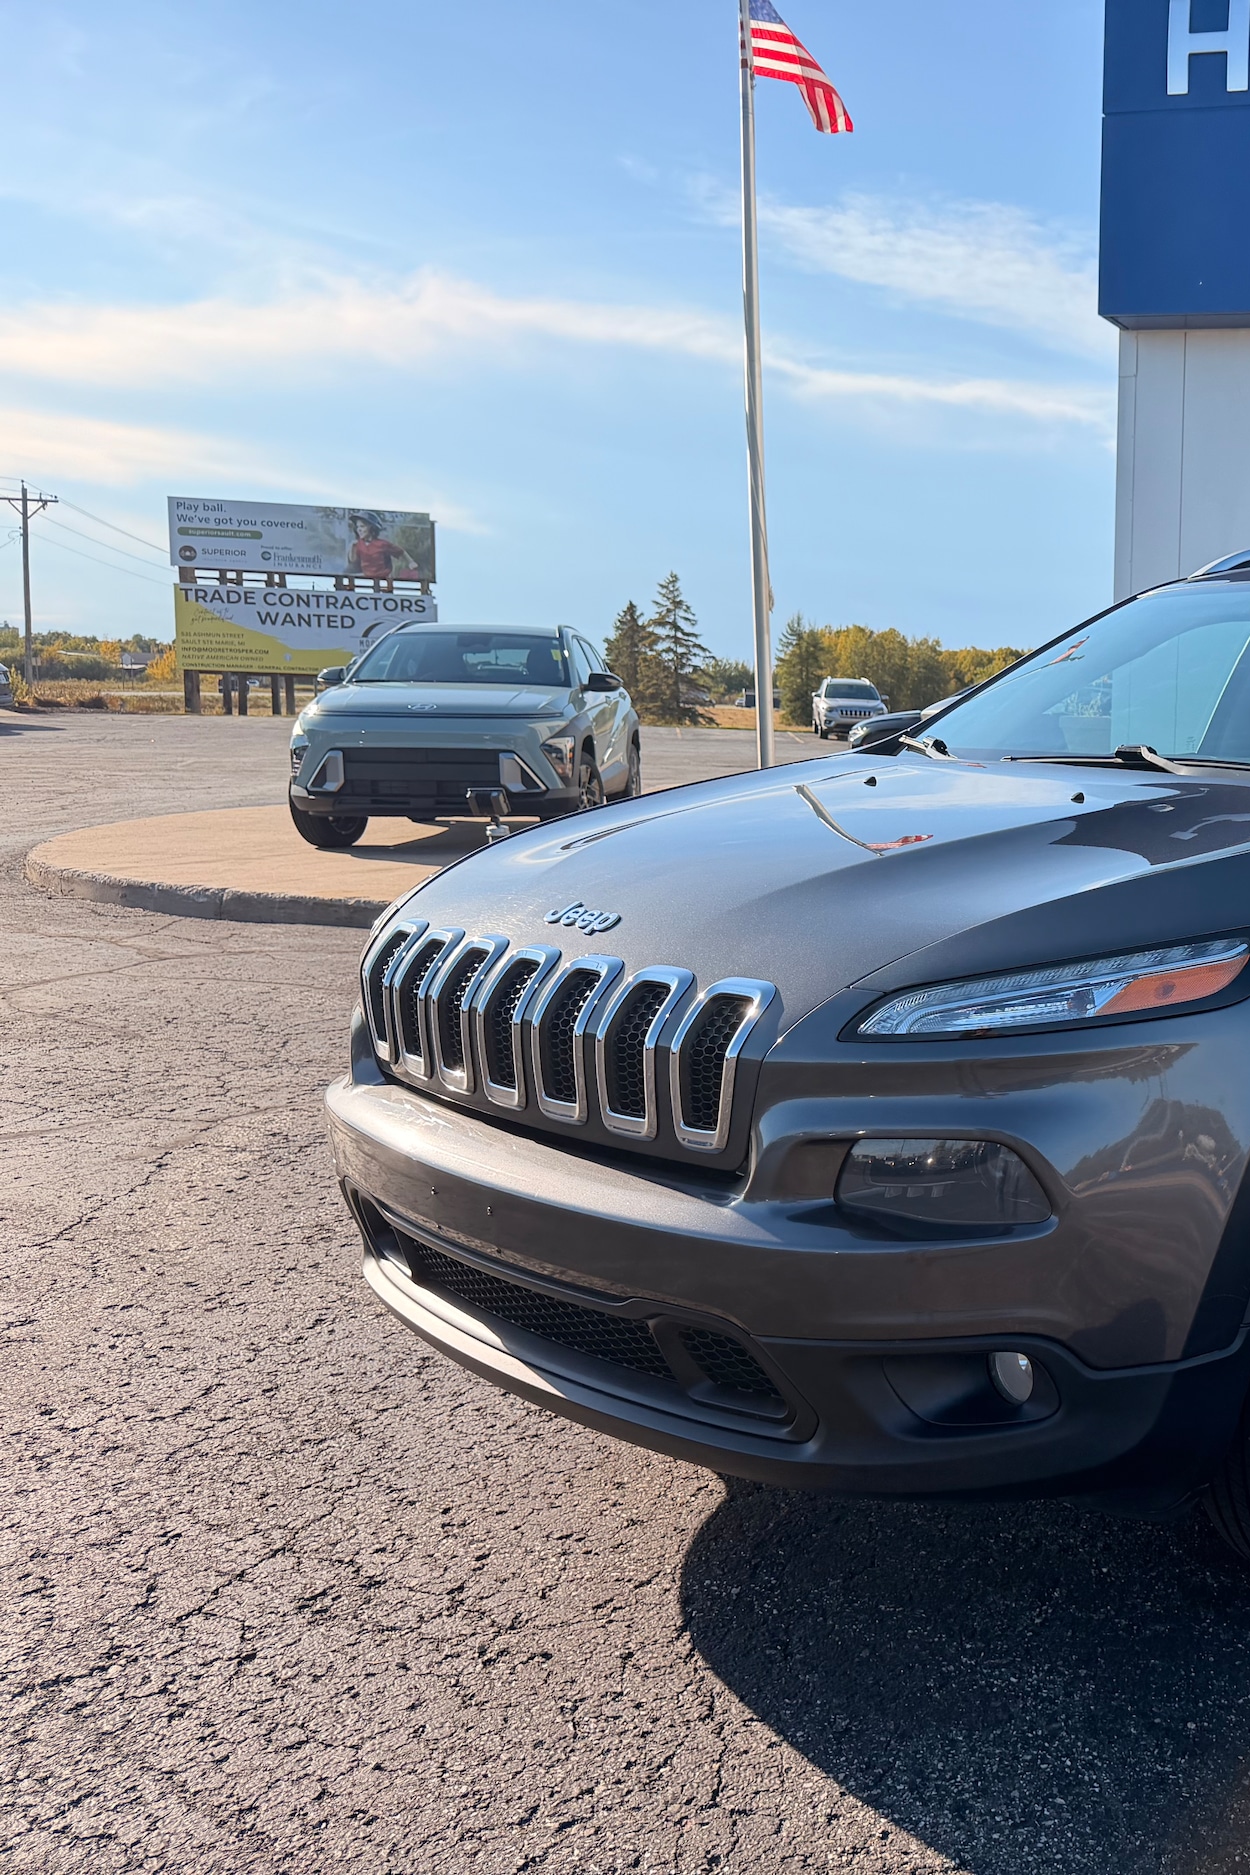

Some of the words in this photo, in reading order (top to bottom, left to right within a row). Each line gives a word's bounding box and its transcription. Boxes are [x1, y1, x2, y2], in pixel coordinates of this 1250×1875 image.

[176, 501, 199, 513] Play
[203, 503, 226, 513] ball.
[176, 514, 210, 524] We've
[214, 516, 233, 527] got
[236, 518, 257, 528] you
[261, 519, 308, 530] covered.
[188, 529, 252, 538] superiorsault.com
[201, 548, 247, 558] SUPERIOR
[179, 588, 257, 605] TRADE
[263, 592, 426, 613] CONTRACTORS
[256, 611, 356, 629] WANTED
[182, 646, 269, 655] INFO@MOORETROSPER.COM
[543, 901, 621, 935] Jeep
